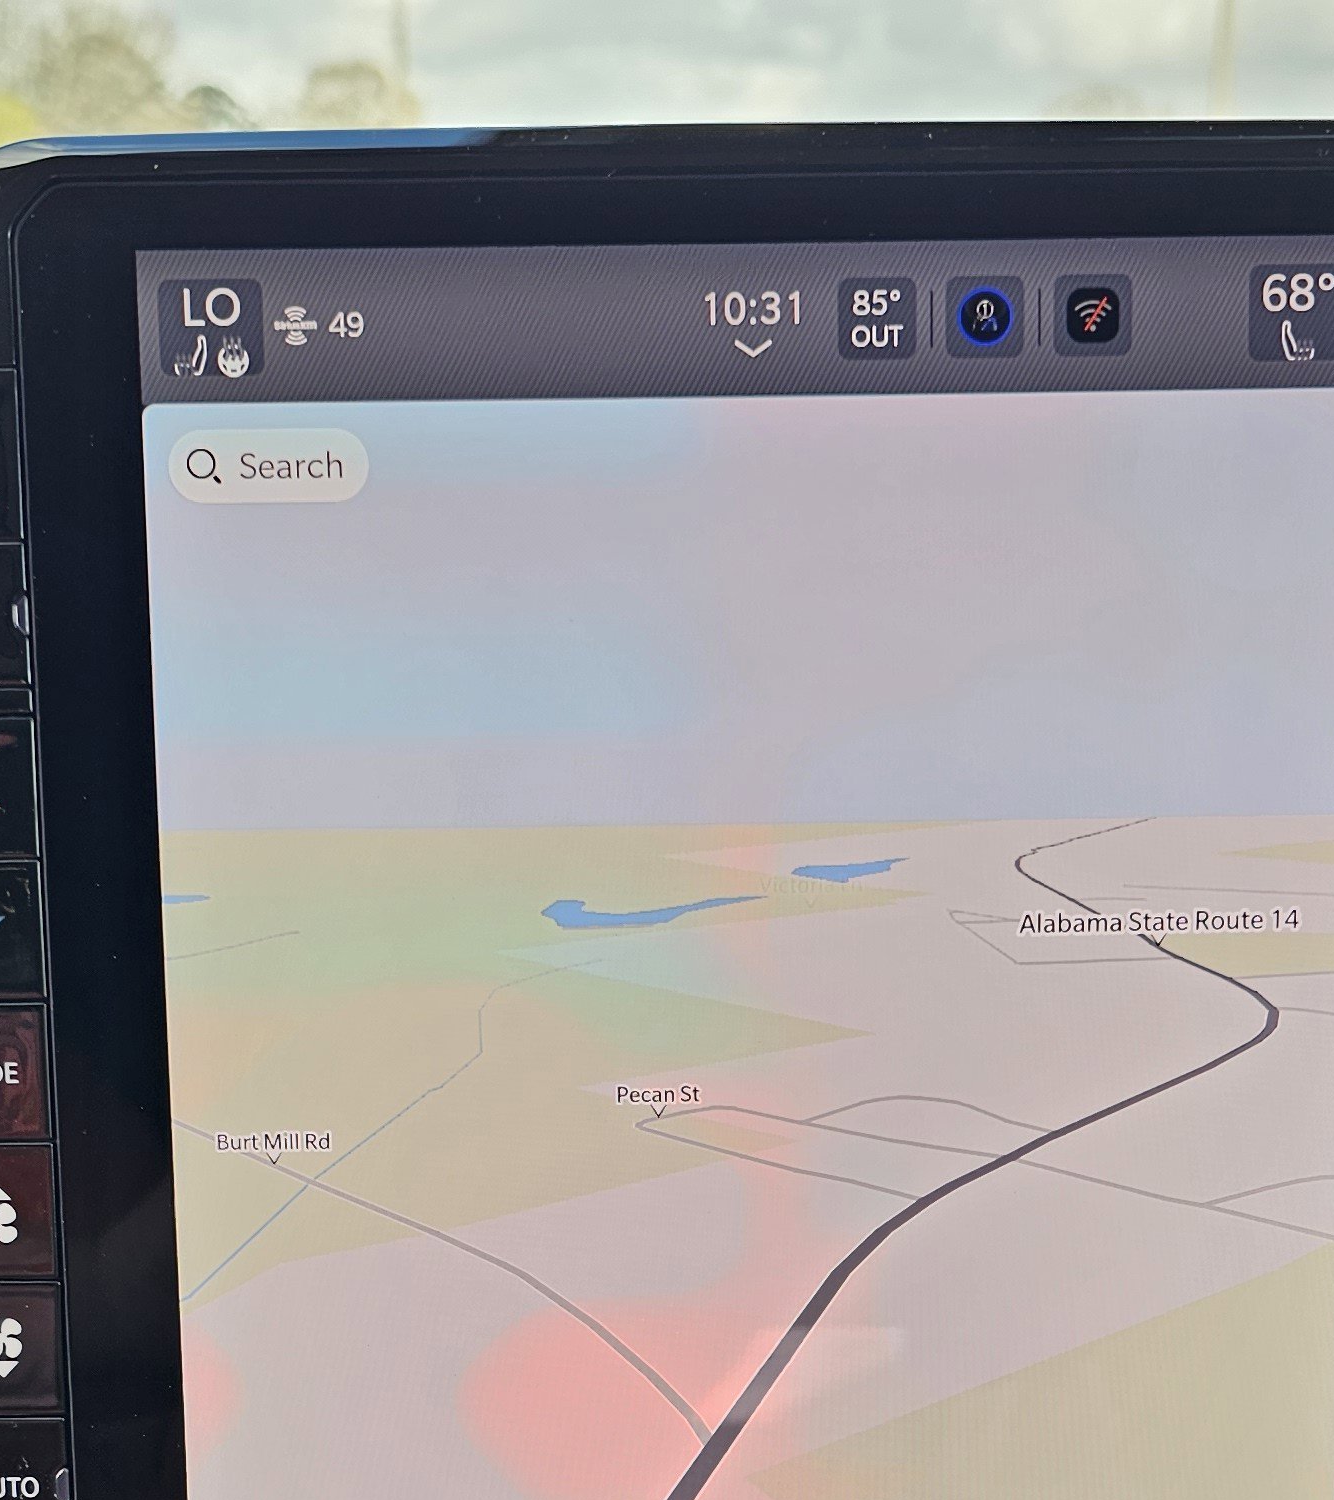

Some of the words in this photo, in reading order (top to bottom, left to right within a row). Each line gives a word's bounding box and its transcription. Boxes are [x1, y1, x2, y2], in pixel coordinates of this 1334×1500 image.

[182, 287, 240, 327] LO
[703, 291, 802, 326] 10:31
[852, 289, 902, 316] 85°
[328, 311, 365, 338] 49
[851, 325, 904, 349] OUT
[239, 451, 344, 480] Search
[1019, 913, 1123, 934] Alabama
[1128, 911, 1189, 932] State
[1195, 911, 1264, 931] Route
[1271, 909, 1300, 930] 14
[616, 1085, 675, 1103] Pecan
[679, 1085, 701, 1103] St
[217, 1132, 258, 1151] Burt
[264, 1132, 299, 1150] Mill
[304, 1132, 331, 1150] Rd
